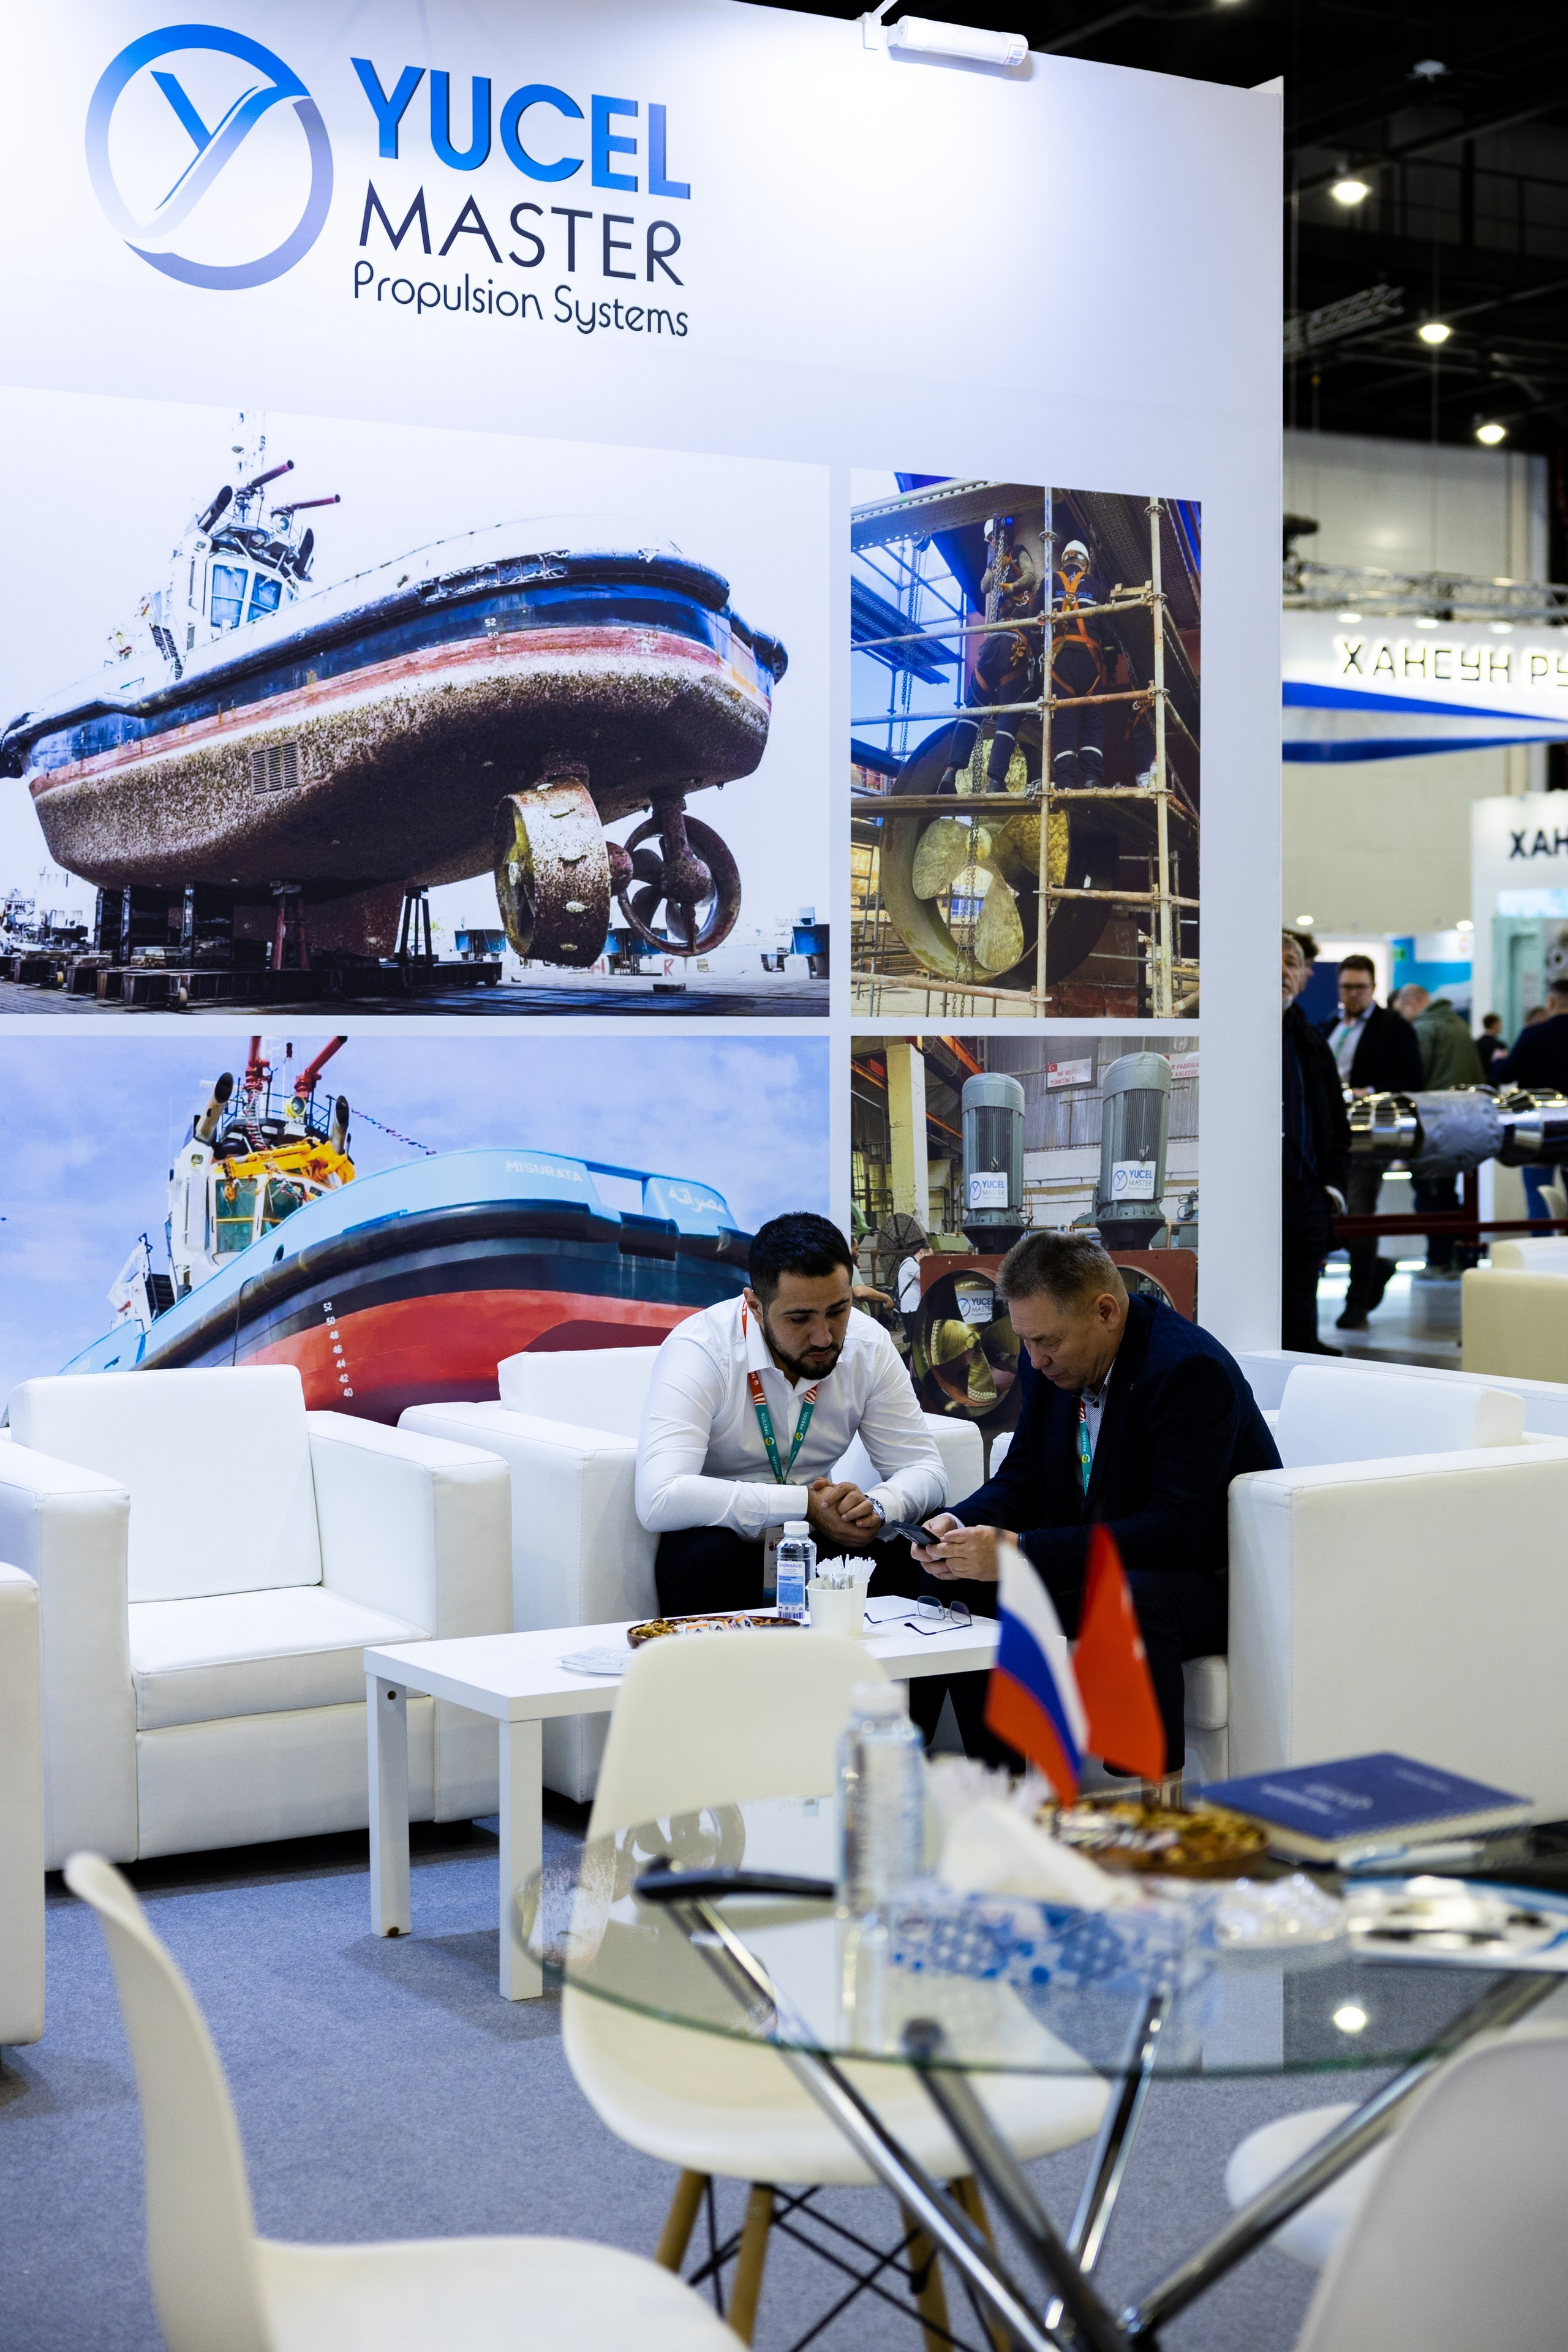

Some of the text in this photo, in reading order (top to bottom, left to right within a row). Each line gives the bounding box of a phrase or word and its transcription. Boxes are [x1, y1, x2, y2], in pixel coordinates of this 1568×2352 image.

[350, 56, 691, 200] YUCEL
[359, 179, 685, 286] MASTER
[354, 260, 688, 337] Propulsion Systems
[484, 617, 497, 627] 52
[488, 631, 499, 640] 50
[1343, 642, 1511, 684] ХАНСУН
[506, 1160, 583, 1183] MISURATA
[1129, 1169, 1152, 1178] YUCEL
[323, 1302, 333, 1312] 52
[326, 1316, 336, 1326] 50
[339, 1373, 349, 1384] 42
[344, 1387, 353, 1397] 40
[761, 1412, 770, 1436] ПРЕГОЛЬ
[799, 1411, 809, 1430] PREGOL
